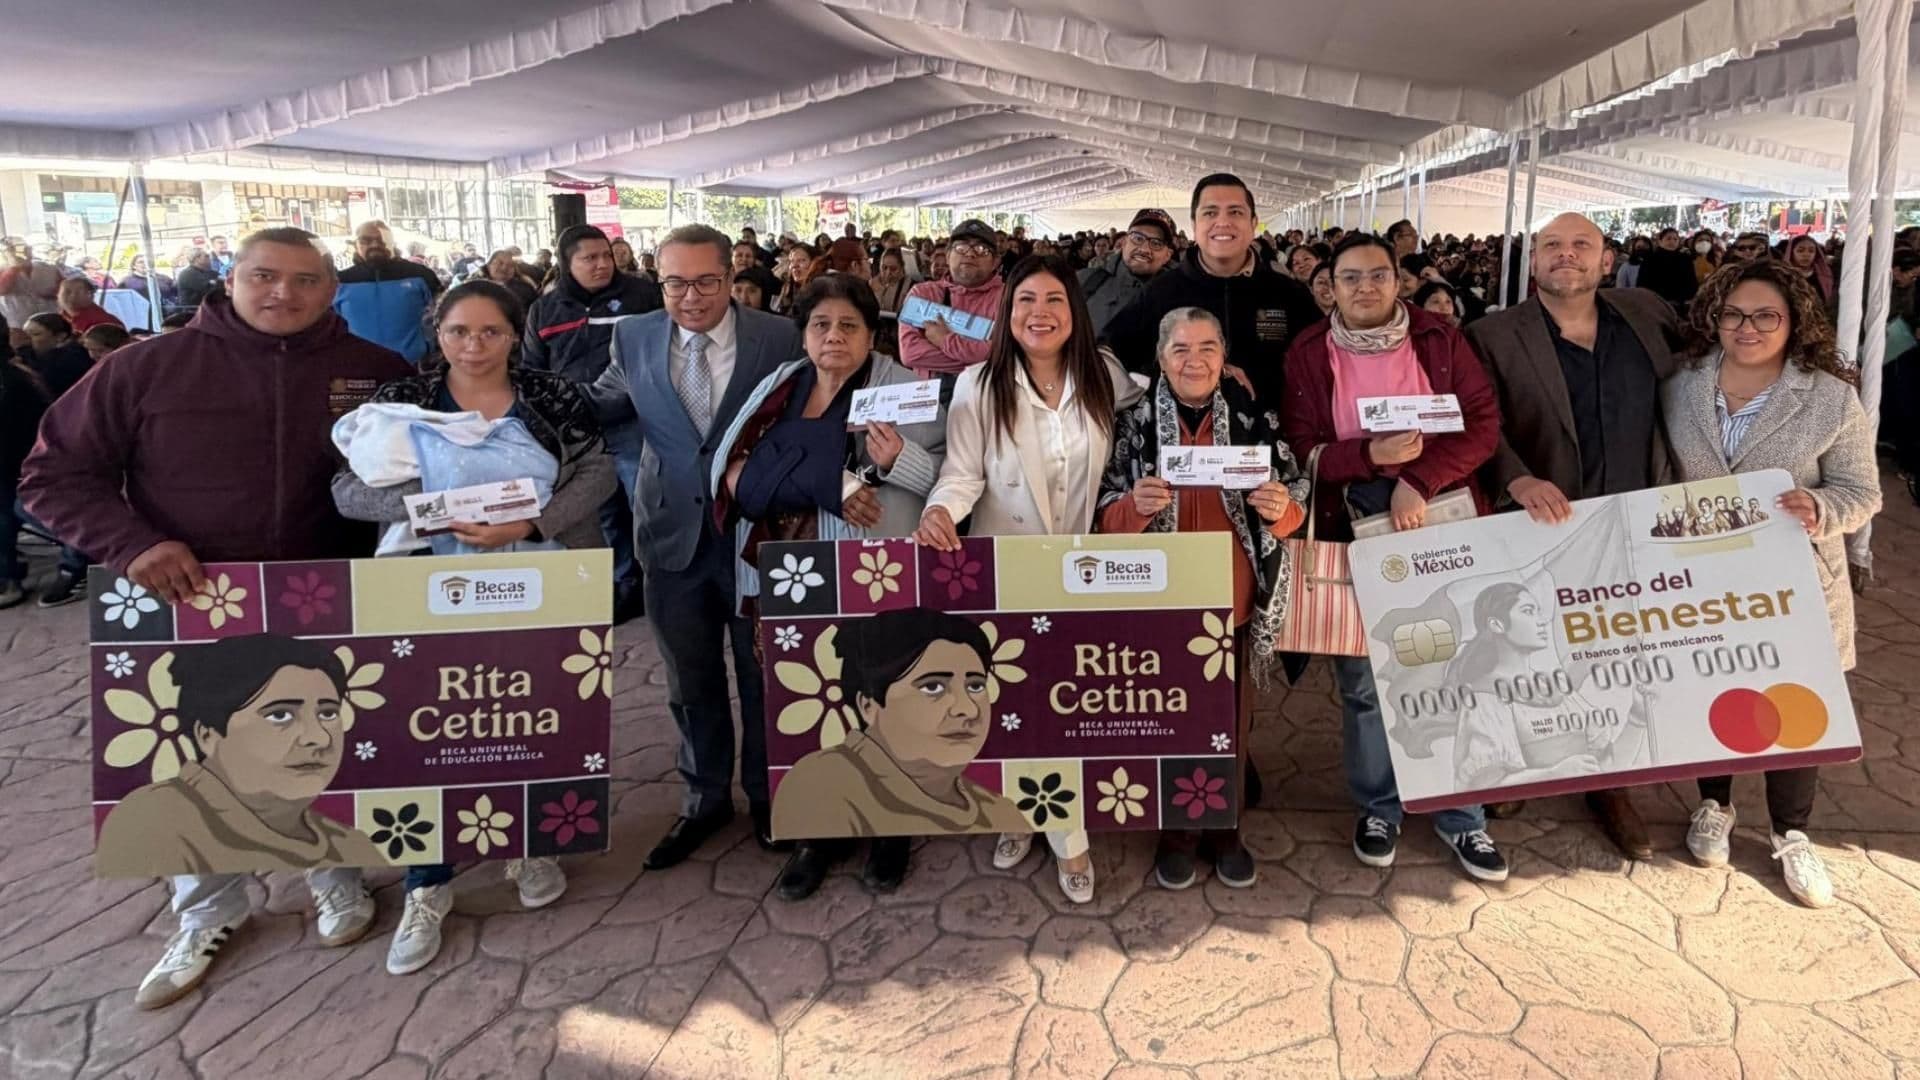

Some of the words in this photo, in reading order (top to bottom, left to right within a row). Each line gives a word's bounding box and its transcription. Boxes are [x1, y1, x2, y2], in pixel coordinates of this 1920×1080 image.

[1411, 548, 1458, 561] Gobierno
[1459, 544, 1471, 553] de
[1105, 561, 1151, 574] Becas
[1413, 555, 1474, 576] México
[475, 580, 526, 594] Becas
[1556, 580, 1642, 607] Banco
[1650, 568, 1693, 593] del
[1562, 587, 1795, 644] Bienestar
[1074, 642, 1161, 676] Rita
[1571, 652, 1582, 661] El
[1585, 646, 1620, 660] banco
[1622, 644, 1637, 654] de
[1639, 641, 1658, 653] los
[1660, 632, 1725, 649] mexicanos
[438, 663, 532, 701] Rita
[1400, 684, 1477, 719] 0000
[1494, 668, 1573, 704] 0000
[1590, 654, 1674, 690] 0000
[1692, 641, 1781, 677] 0000
[1049, 679, 1188, 715] Cetina
[409, 702, 560, 742] Cetina
[1065, 729, 1077, 737] DE
[1081, 726, 1137, 737] EDUCACIÓN
[1140, 725, 1175, 736] BÁSICA
[1079, 721, 1103, 729] BECA
[1107, 720, 1161, 728] UNIVERSAL
[424, 757, 437, 765] DE
[441, 754, 503, 765] EDUCACIÓN
[506, 751, 544, 761] BÁSICA
[440, 747, 466, 756] BECA
[470, 744, 528, 754] UNIVERSAL
